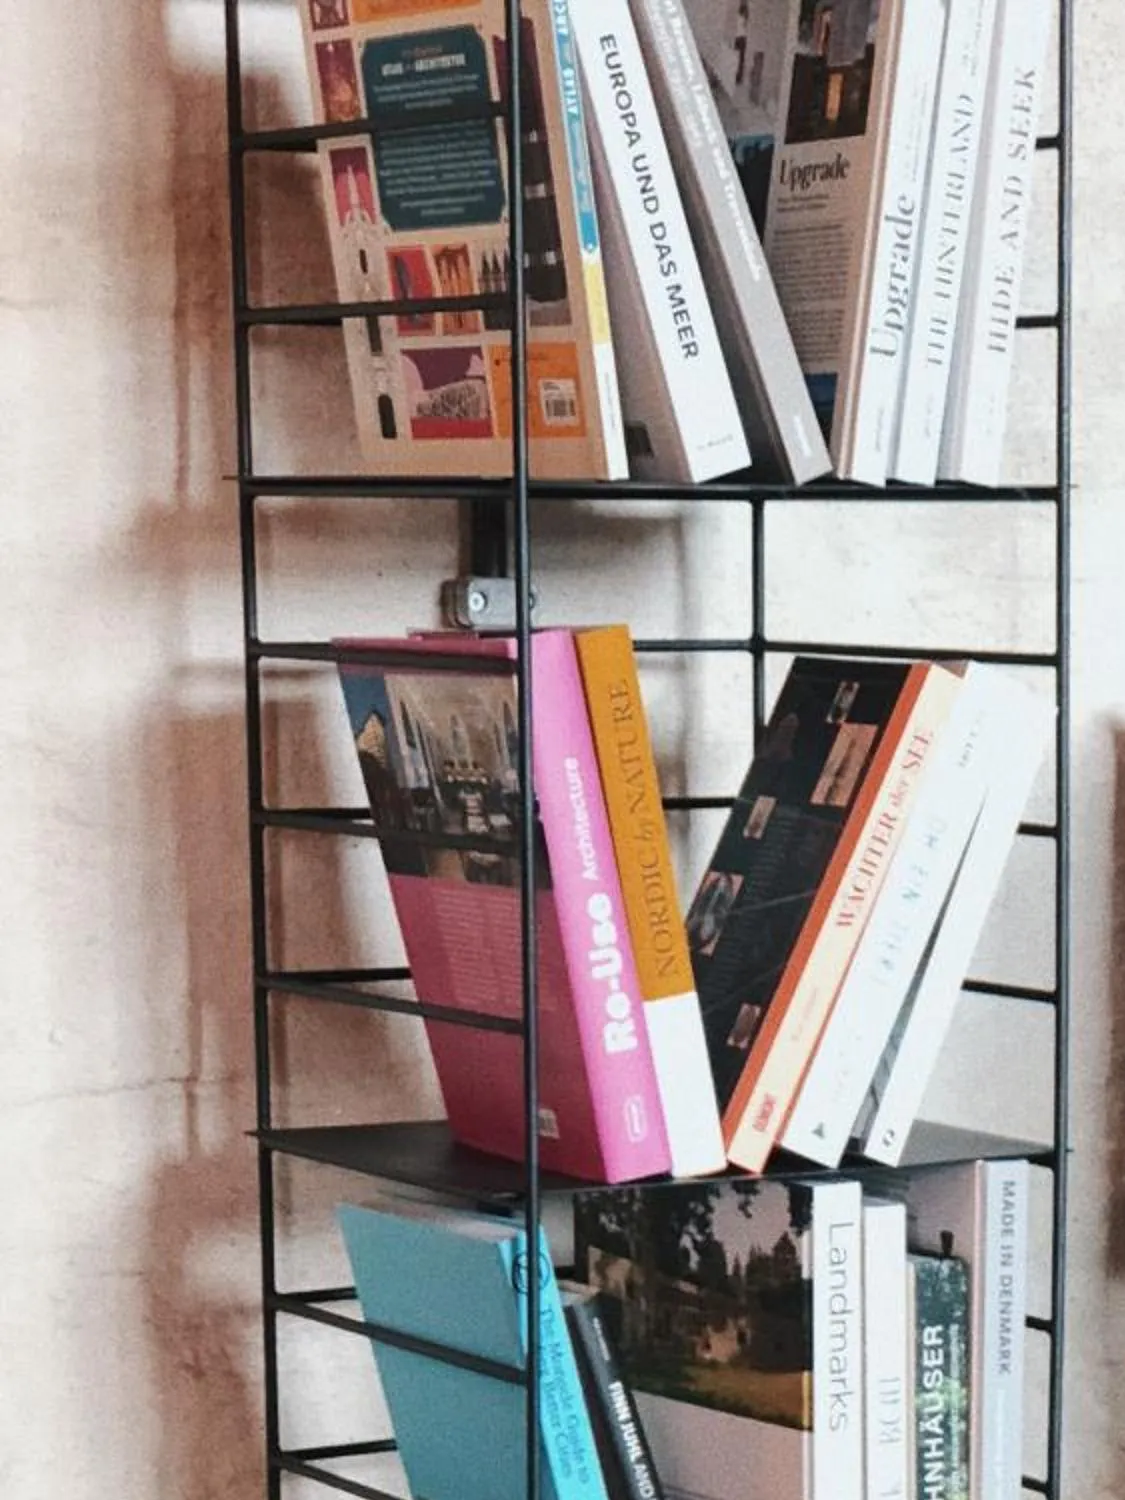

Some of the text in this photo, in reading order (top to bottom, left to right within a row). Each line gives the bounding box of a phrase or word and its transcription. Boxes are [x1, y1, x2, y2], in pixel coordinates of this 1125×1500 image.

[600, 33, 699, 359] EUROPA UND DAS MEER
[780, 152, 851, 192] Upgrade
[934, 94, 973, 300] HINTERLAND
[988, 69, 1036, 353] HIDE AND SEEK
[869, 195, 915, 357] Upgrade
[564, 757, 598, 881] Architecture
[610, 679, 680, 979] NORDIC by NATURE
[999, 1181, 1016, 1237] MADE
[1000, 1244, 1014, 1267] IN
[828, 1221, 855, 1433] Landmarks
[998, 1275, 1014, 1376] DENMARK
[608, 1380, 633, 1421] FINN
[621, 1421, 644, 1463] JUHL
[633, 1463, 655, 1498] AND
